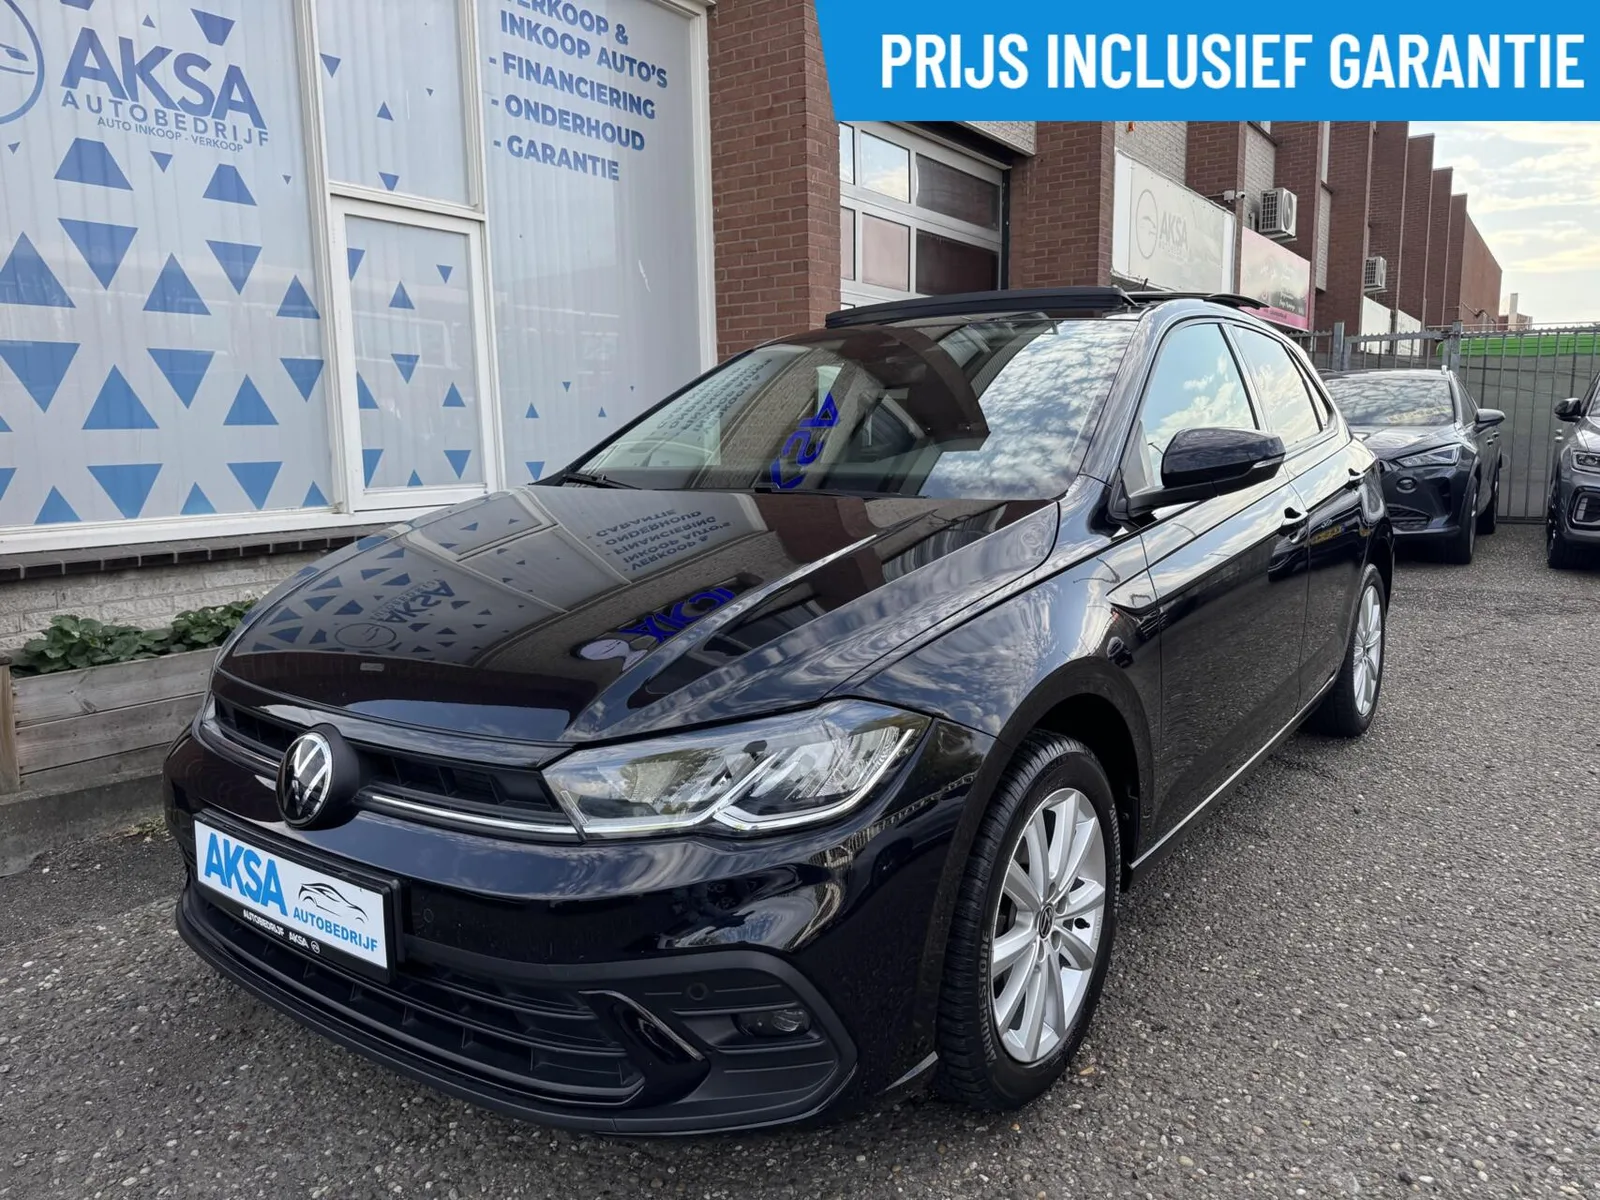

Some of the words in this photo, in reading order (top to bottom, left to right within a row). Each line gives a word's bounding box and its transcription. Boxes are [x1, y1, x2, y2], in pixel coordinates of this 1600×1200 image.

[501, 10, 591, 59] INKOOP
[597, 47, 668, 89] AUTO'S
[508, 0, 609, 36] RKOOP
[614, 23, 629, 46] &
[60, 26, 267, 130] AKSA
[503, 52, 656, 120] FINANCIERING
[61, 90, 269, 147] AUTOBEDRIJF
[97, 117, 132, 132] AUTO
[135, 123, 182, 141] INKOOP
[191, 134, 244, 153] VERKOOP
[505, 94, 645, 151] ONDERHOUD
[507, 135, 620, 182] GARANTIE
[1159, 210, 1188, 252] AKSA
[204, 832, 288, 917] AKSA
[243, 909, 285, 937] AUTOBEDRIJF
[288, 931, 310, 949] AKSA
[293, 906, 379, 952] AUTOBEDRIJF
[978, 930, 998, 1066] BRIDGESTONE
